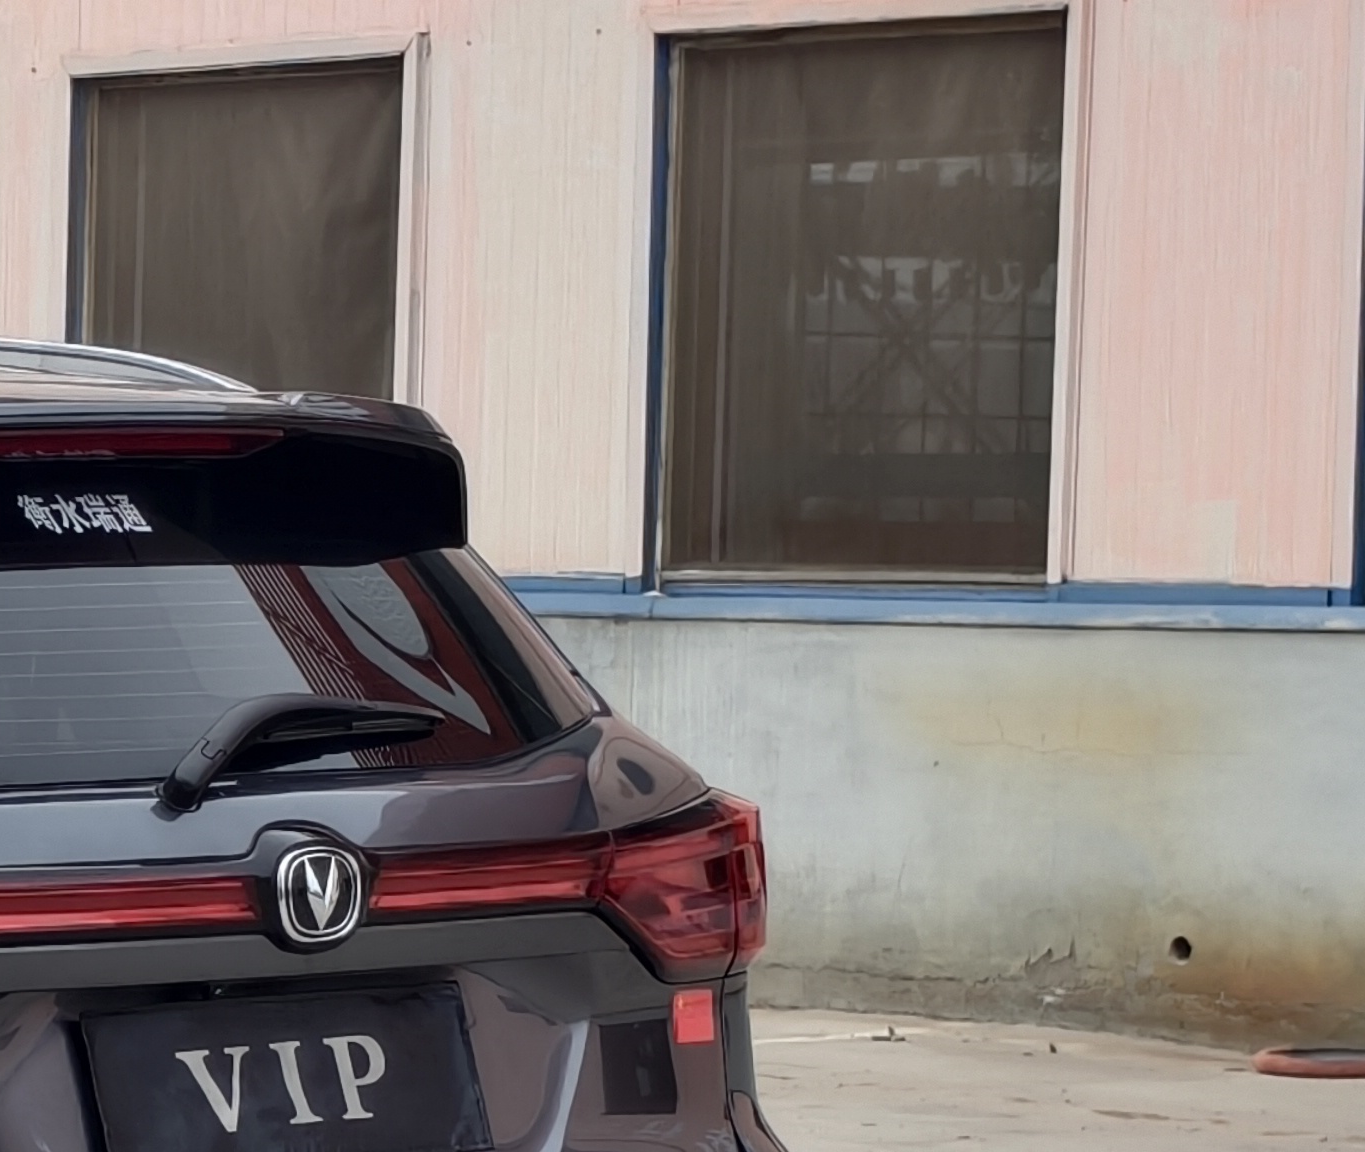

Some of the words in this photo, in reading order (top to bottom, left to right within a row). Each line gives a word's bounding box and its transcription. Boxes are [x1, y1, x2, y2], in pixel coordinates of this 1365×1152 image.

[17, 493, 153, 534] 衡水瑞通
[175, 1034, 387, 1133] VIP
